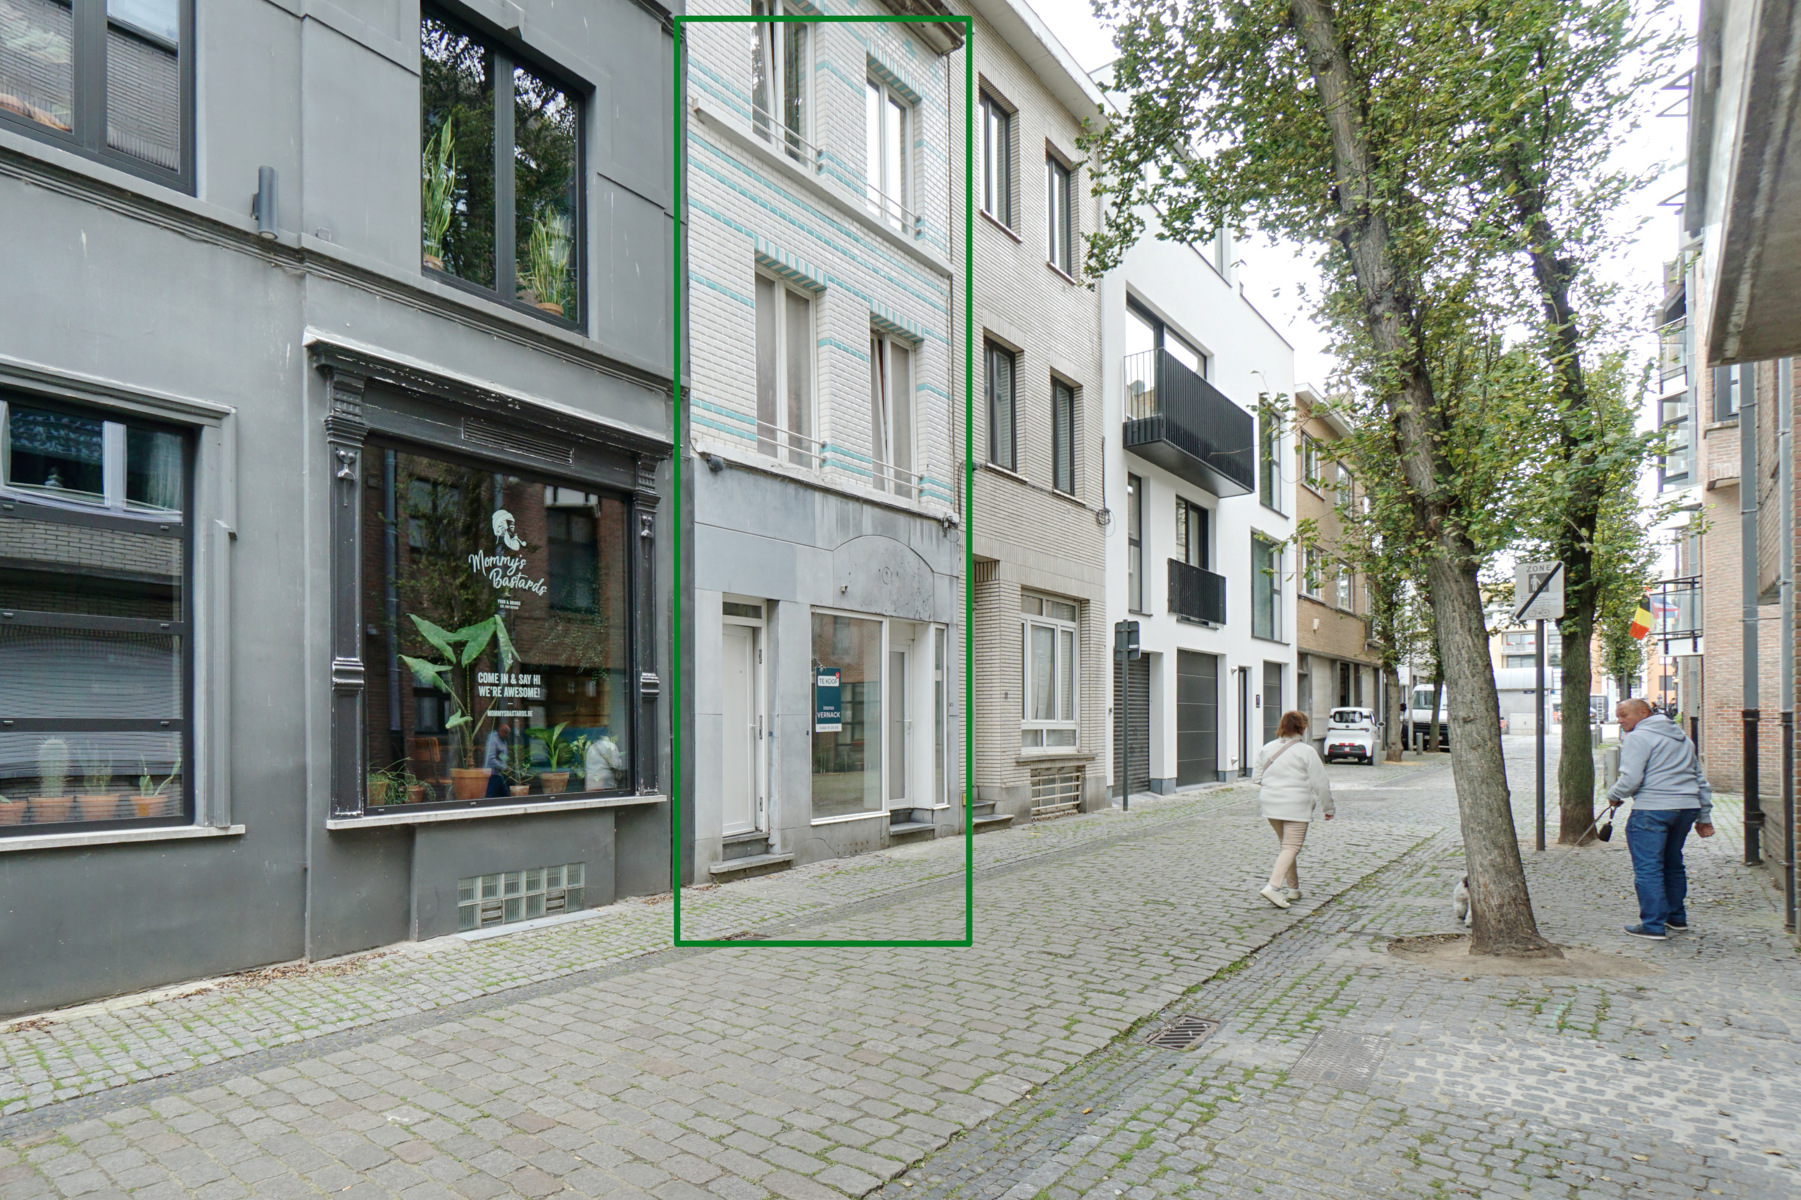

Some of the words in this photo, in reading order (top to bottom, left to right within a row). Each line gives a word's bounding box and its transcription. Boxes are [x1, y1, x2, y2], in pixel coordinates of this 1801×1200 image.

[468, 549, 527, 576] Mommy's
[1526, 564, 1552, 573] ZONE
[489, 568, 548, 596] Bastards
[478, 672, 499, 684] COME
[501, 673, 508, 684] IN
[510, 673, 517, 685] &
[518, 674, 532, 685] SAY
[533, 674, 541, 685] HI
[478, 686, 502, 697] WE'RE
[503, 686, 541, 698] AWESOME!
